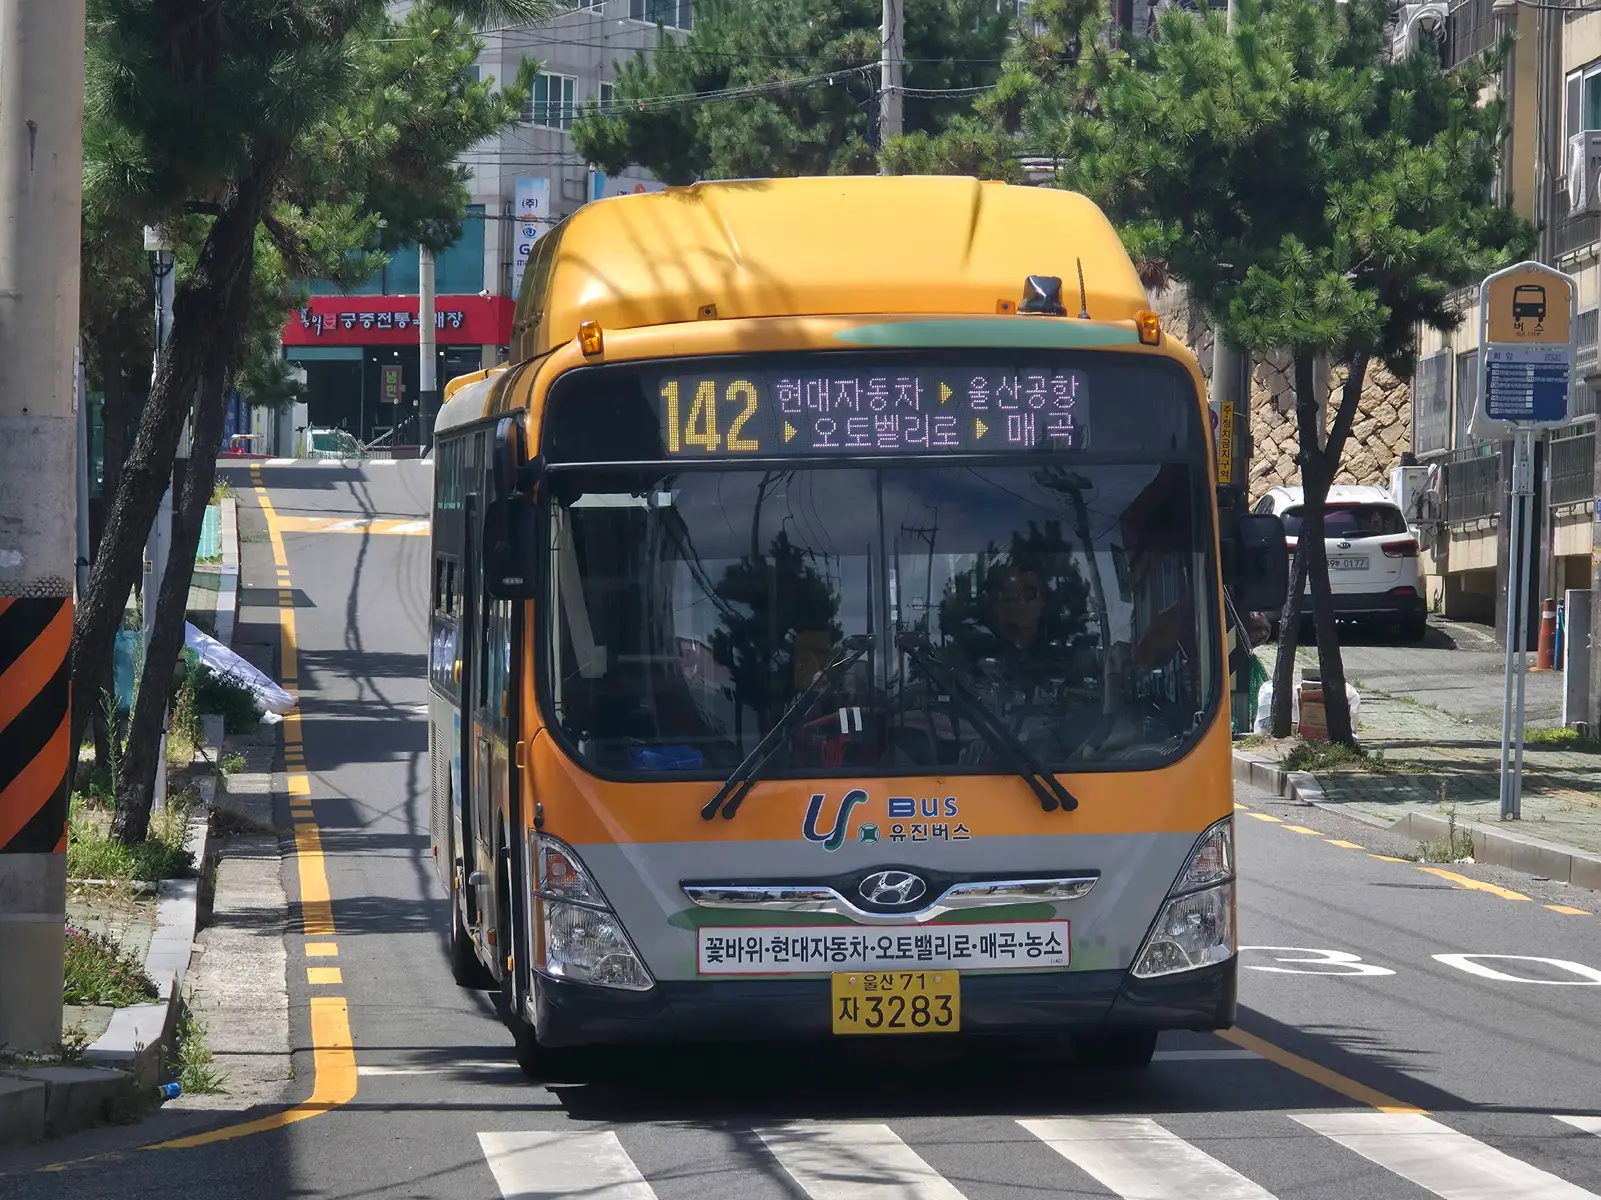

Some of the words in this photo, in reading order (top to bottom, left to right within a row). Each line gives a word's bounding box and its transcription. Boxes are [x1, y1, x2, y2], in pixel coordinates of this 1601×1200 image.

[340, 311, 464, 329] 궁중전통개장
[776, 376, 924, 413] 현대자동차
[967, 375, 1080, 410] 울산공항
[660, 379, 760, 452] 142
[889, 823, 972, 842] 유진버스
[863, 974, 894, 992] 울산
[900, 973, 925, 991] 71
